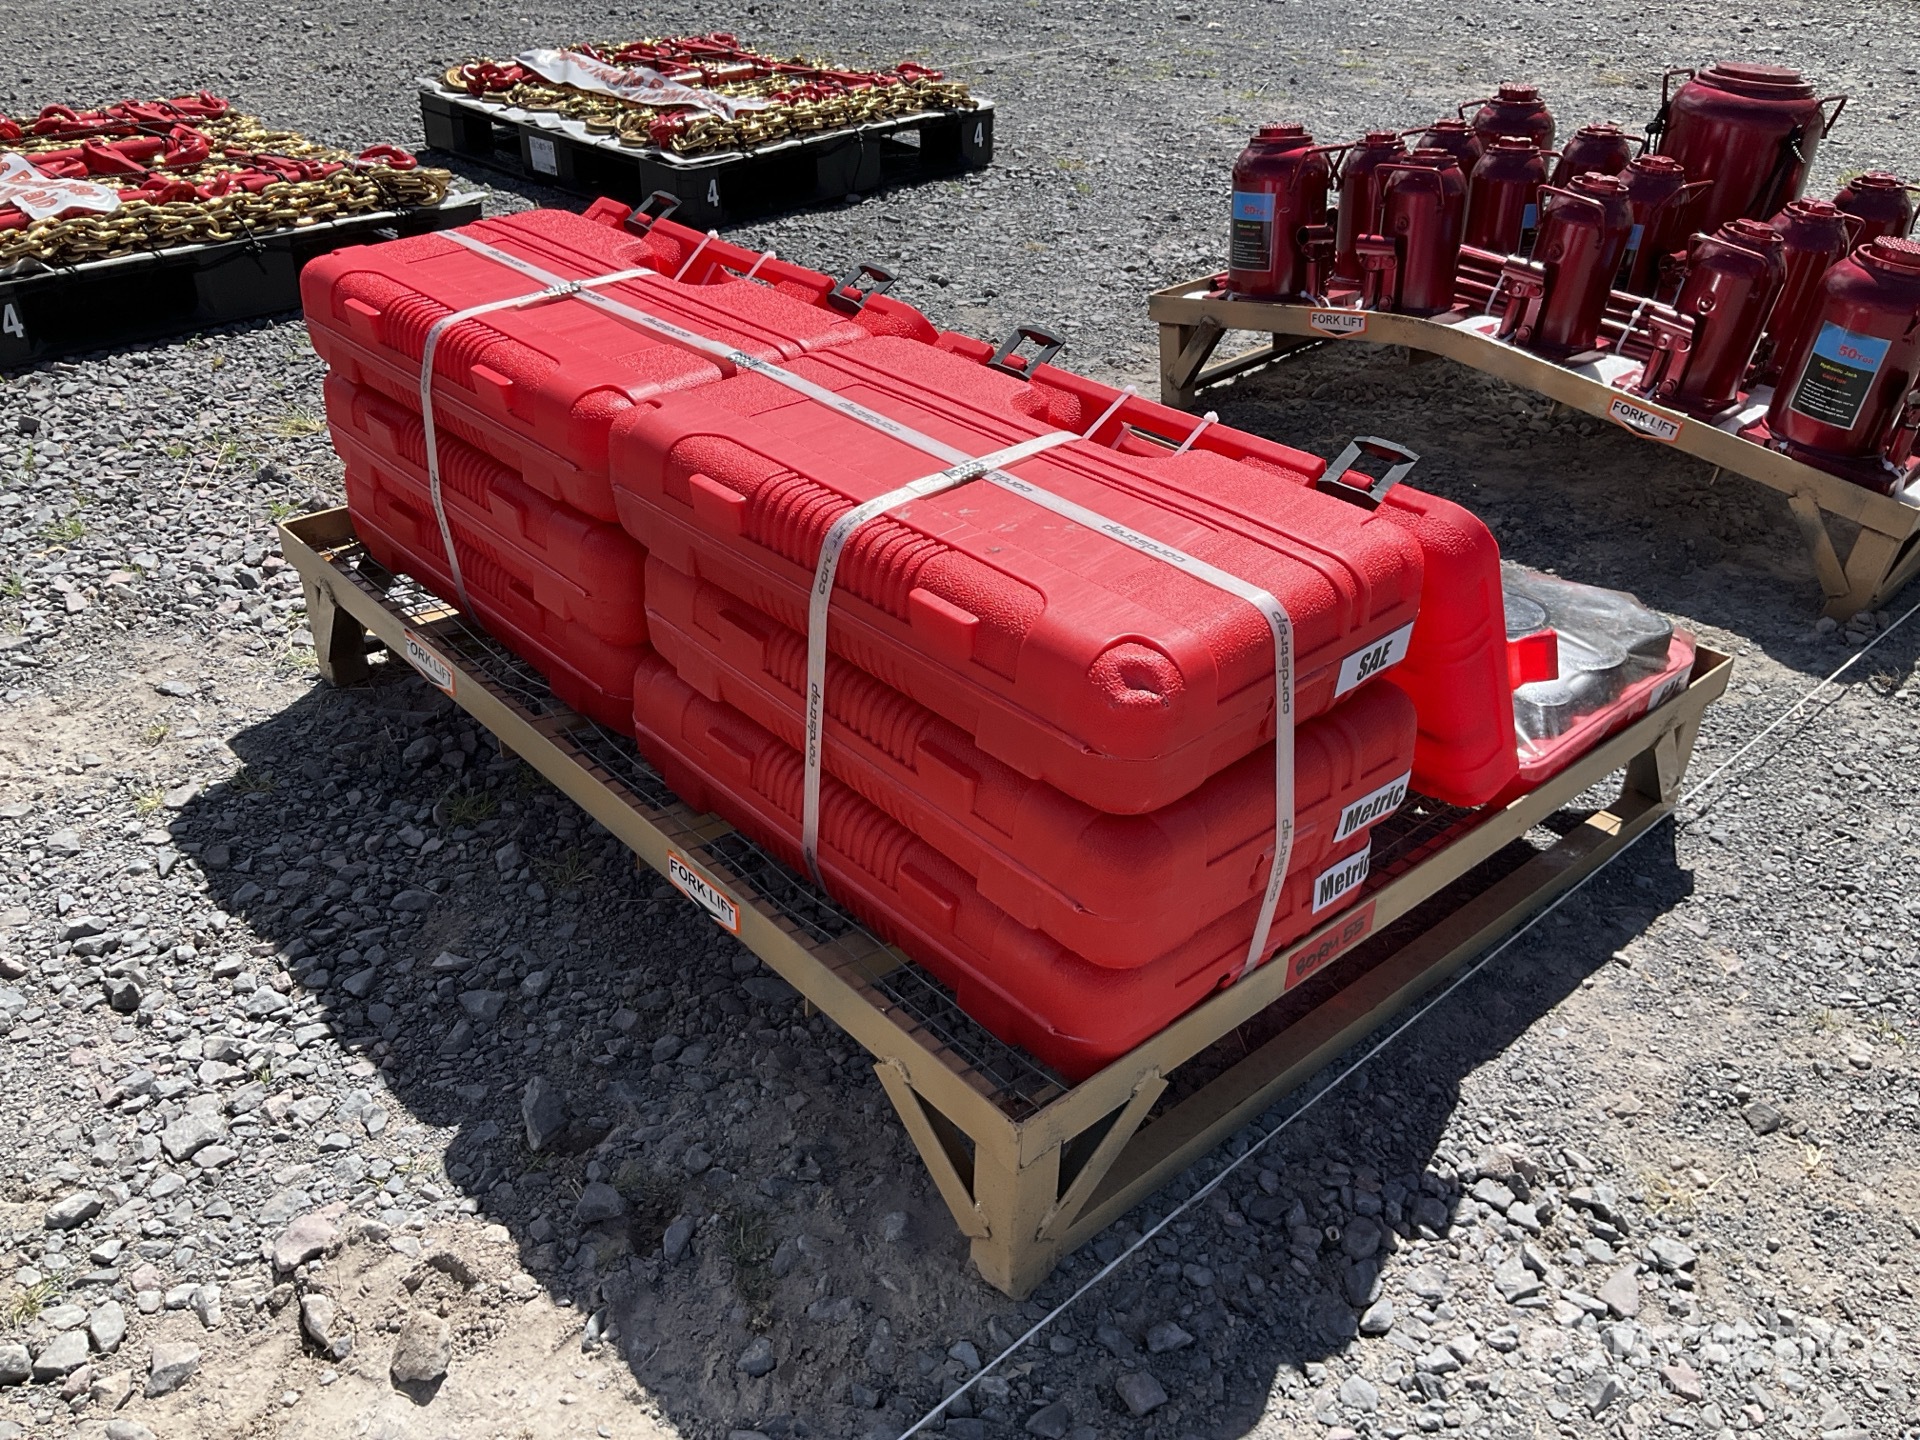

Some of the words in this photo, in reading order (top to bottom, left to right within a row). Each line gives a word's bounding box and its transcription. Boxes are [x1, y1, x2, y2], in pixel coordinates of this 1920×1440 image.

[974, 122, 984, 148] 4
[707, 179, 720, 207] 4
[3, 303, 24, 338] 4
[1311, 314, 1340, 325] FORK
[1343, 316, 1364, 327] LIFT
[837, 402, 901, 432] cordstrap
[1612, 401, 1649, 424] FORK
[1649, 416, 1678, 436] LIFT
[1101, 523, 1187, 563] cordstrap
[1271, 610, 1290, 715] cordstrap
[1356, 639, 1394, 681] SAE
[808, 682, 822, 768] cordstrap
[1342, 784, 1405, 836] Metric
[669, 858, 707, 898] FORK
[709, 888, 734, 922] LIFT
